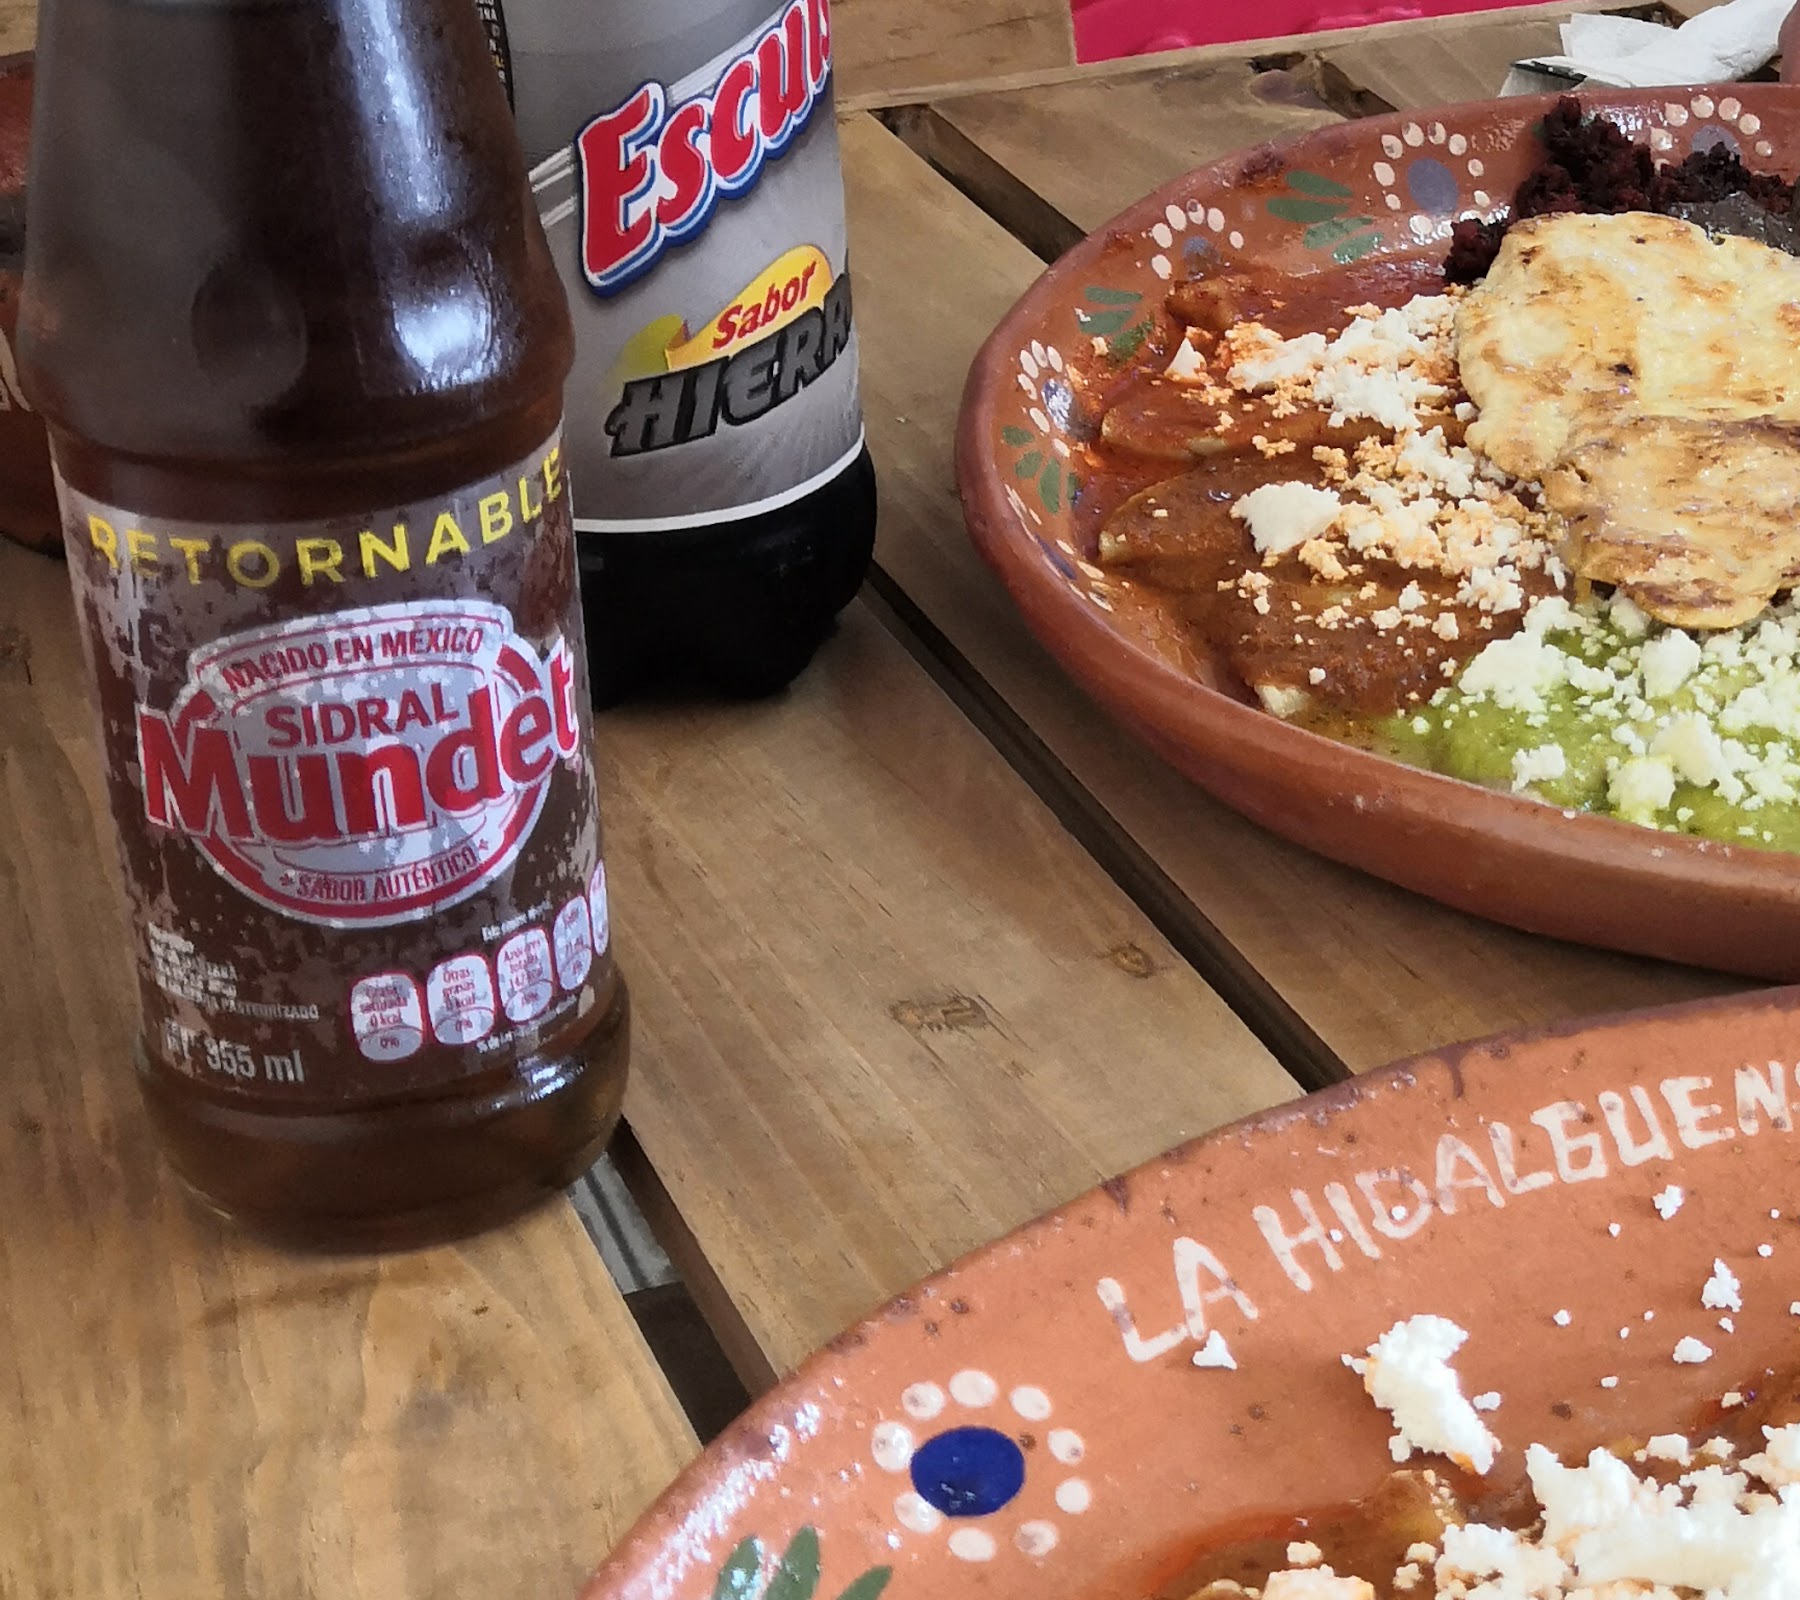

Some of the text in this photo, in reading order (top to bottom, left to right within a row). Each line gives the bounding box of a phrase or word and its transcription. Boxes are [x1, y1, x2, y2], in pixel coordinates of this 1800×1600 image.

[712, 259, 817, 351] Sabor
[604, 273, 853, 458] HIERR
[87, 446, 561, 588] RETORNABLE
[221, 642, 328, 693] NACIDO
[334, 634, 374, 665] EN
[264, 683, 459, 748] SIDRAL
[296, 873, 365, 900] SABOR
[263, 1049, 305, 1083] ml
[1096, 1236, 1259, 1363] LA
